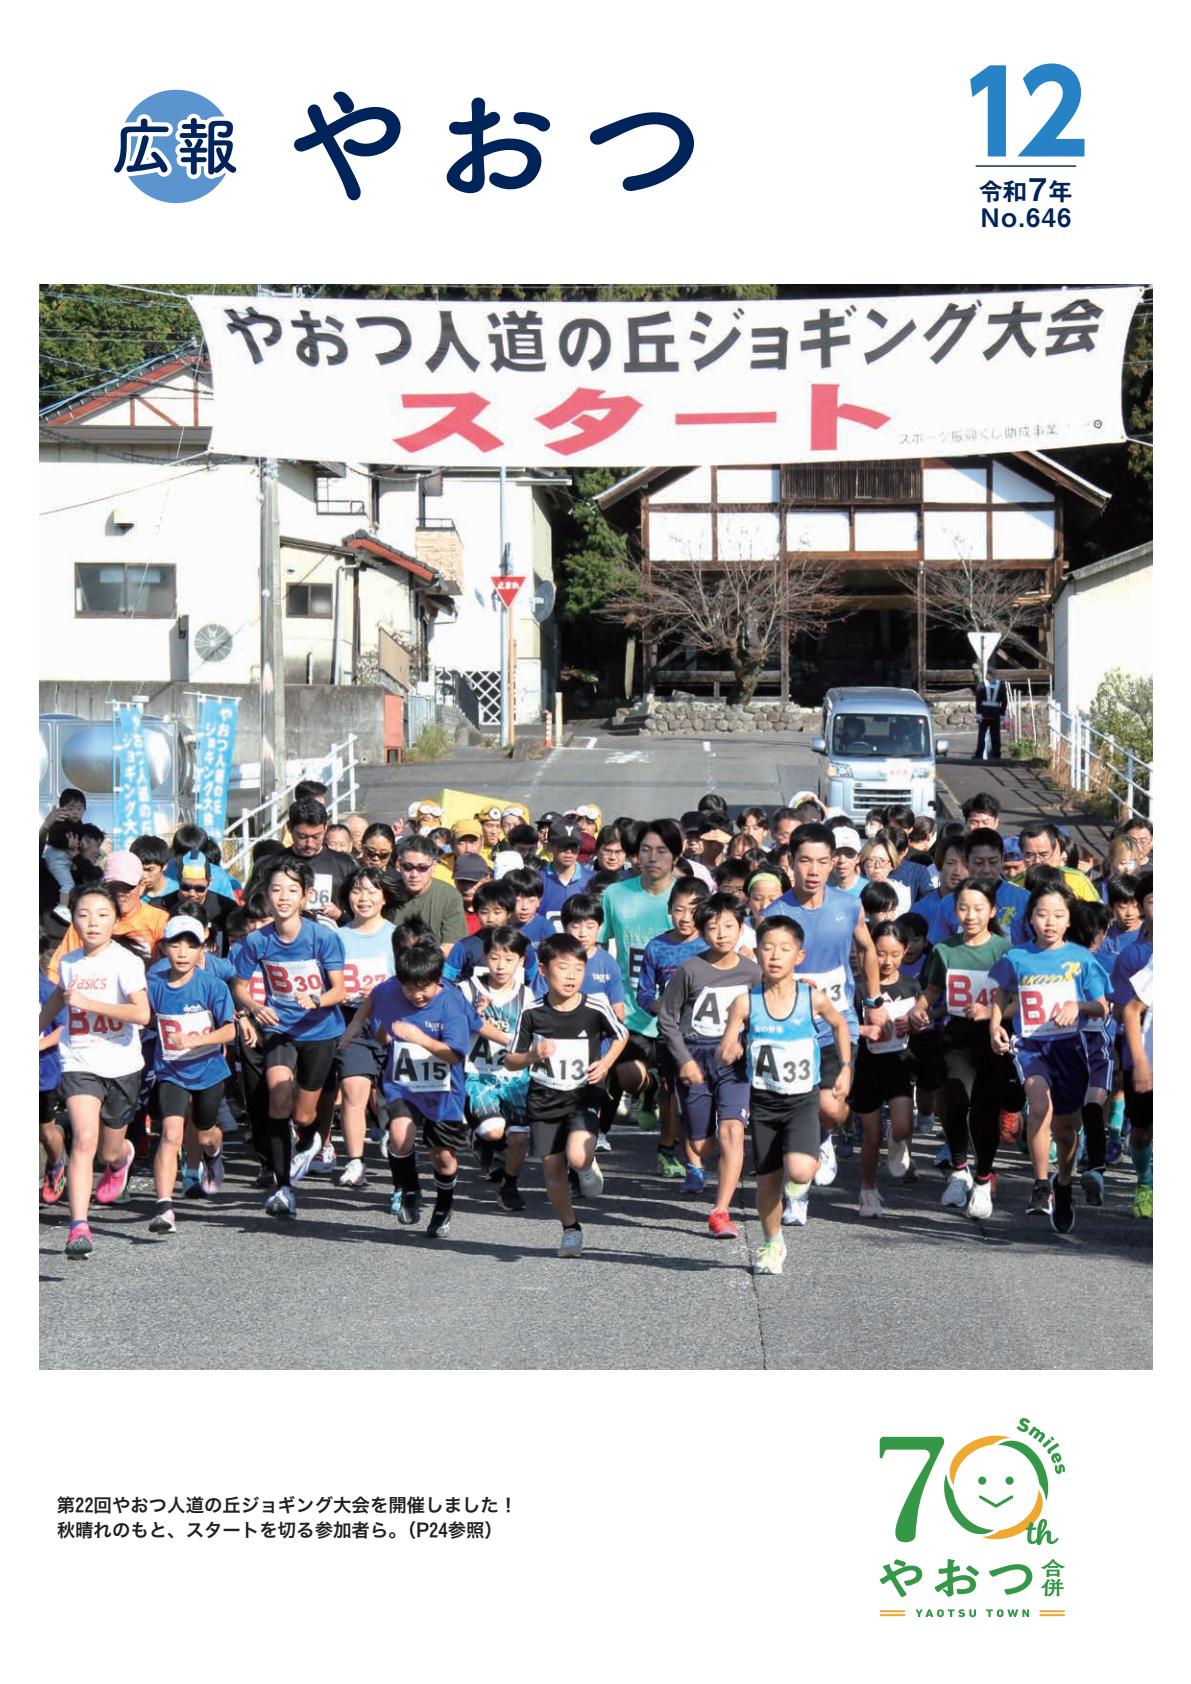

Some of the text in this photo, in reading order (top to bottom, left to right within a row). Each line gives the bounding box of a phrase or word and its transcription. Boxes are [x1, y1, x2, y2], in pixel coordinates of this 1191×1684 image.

[225, 298, 1103, 372] やおつ人道の丘ジョギング大会
[394, 384, 891, 455] スタート
[266, 964, 321, 993] B30
[394, 1047, 447, 1082] A15
[755, 1044, 811, 1083] A33
